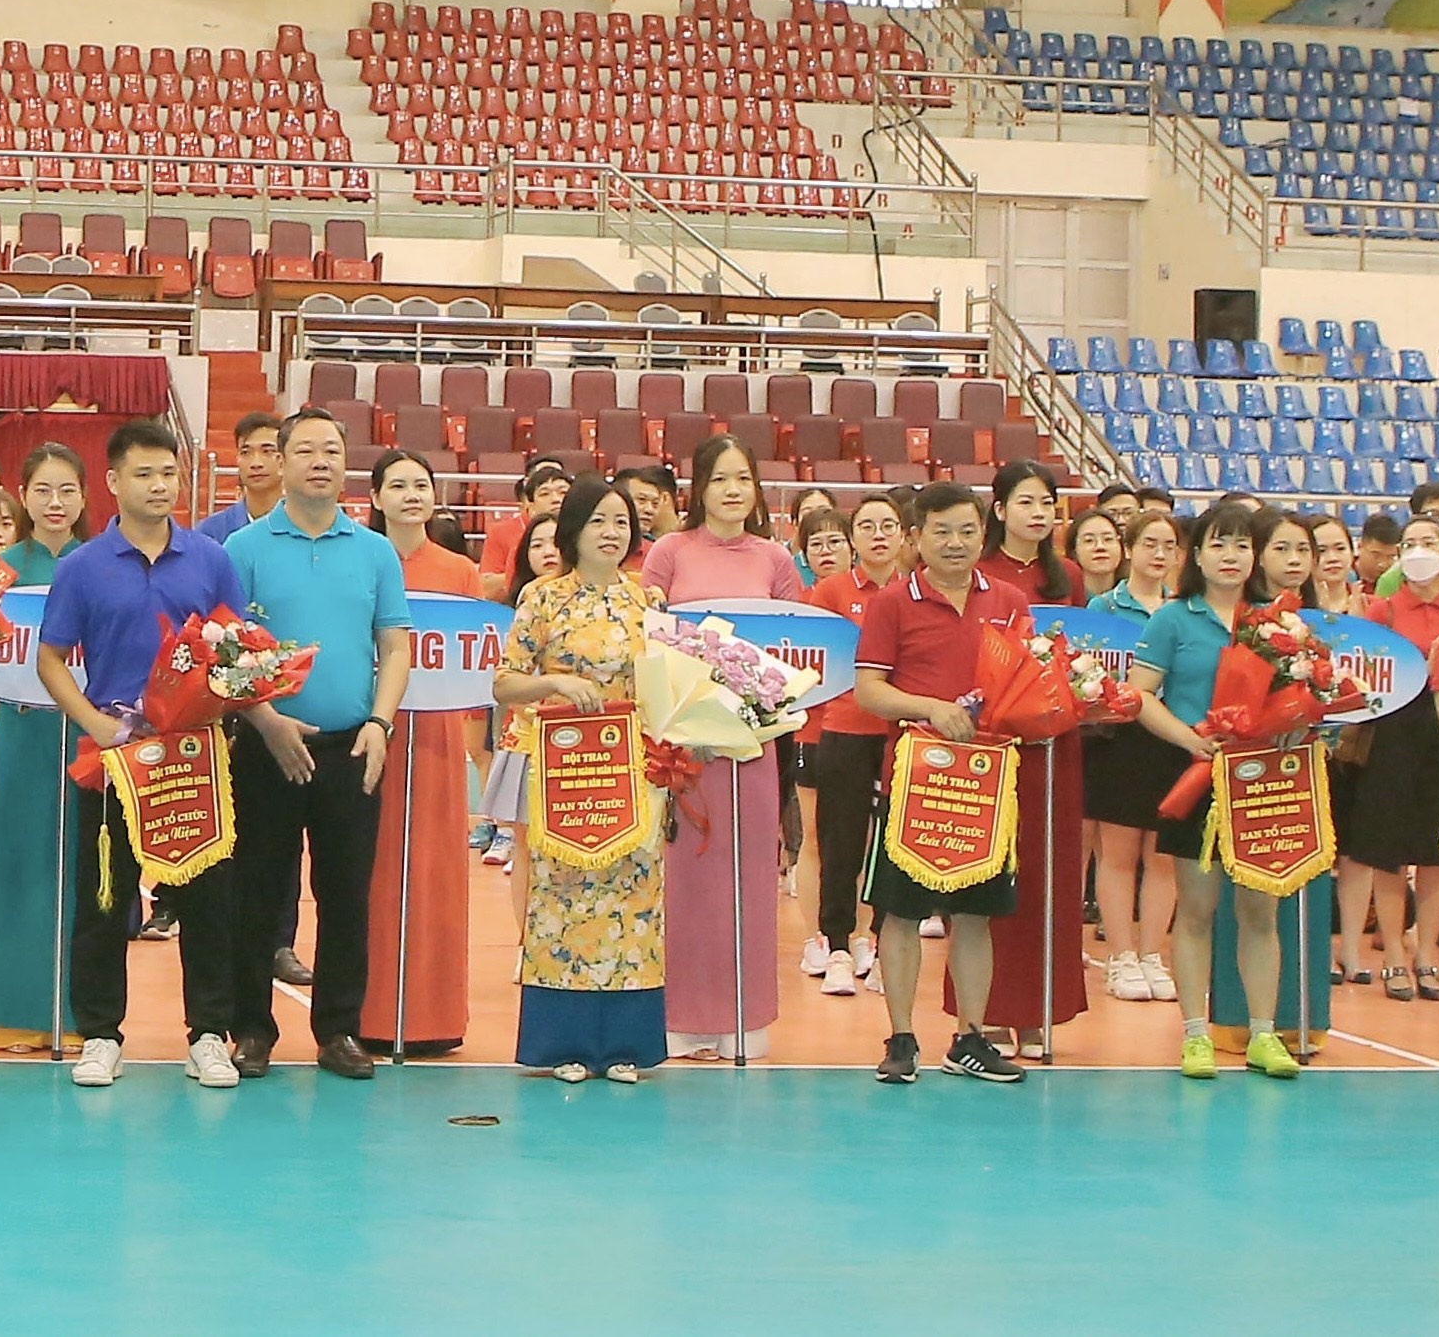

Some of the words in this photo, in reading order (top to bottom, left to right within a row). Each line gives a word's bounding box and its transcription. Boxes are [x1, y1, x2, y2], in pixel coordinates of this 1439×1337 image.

[562, 752, 580, 765] HỘI
[582, 752, 611, 763] THAO
[928, 772, 948, 786] HỘI
[949, 777, 980, 789] THAO
[552, 802, 575, 812] BAN
[577, 797, 593, 811] TỔ
[595, 799, 625, 809] CHỨC
[910, 819, 934, 830] BAN
[936, 820, 953, 833] TỔ
[955, 826, 985, 838] CHỨC
